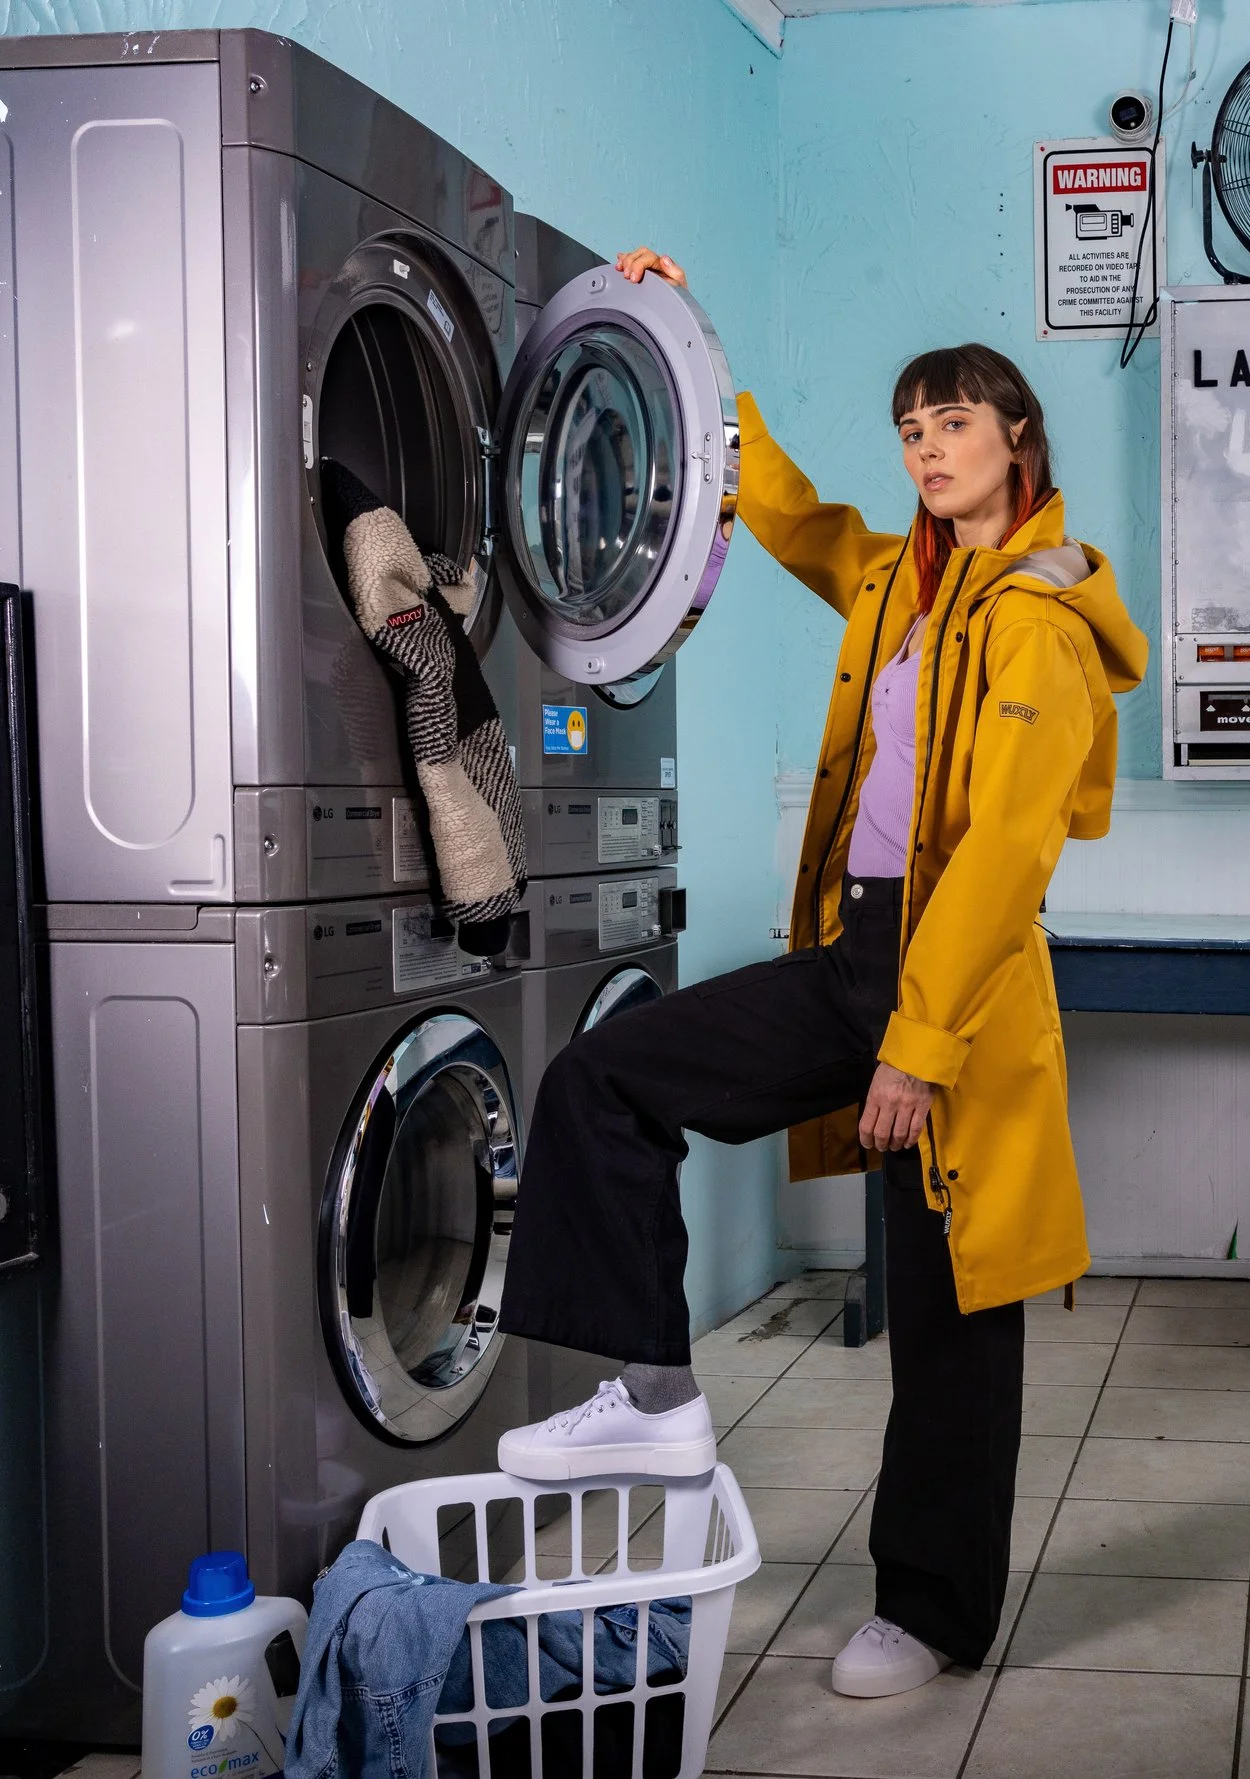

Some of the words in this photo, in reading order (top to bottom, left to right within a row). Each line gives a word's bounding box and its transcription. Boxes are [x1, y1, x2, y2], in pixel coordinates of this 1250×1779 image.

[1057, 167, 1141, 189] WARNING
[1082, 252, 1115, 260] ACTIVITIES
[1059, 264, 1093, 272] RECORDED
[1106, 262, 1124, 270] VIDEO
[1109, 274, 1122, 282] THE
[1066, 286, 1110, 294] PROSECUTION
[1058, 298, 1077, 306] CRIME
[1078, 298, 1115, 306] COMMITTED
[1116, 296, 1144, 304] AGAIST
[1095, 308, 1122, 316] FACILITY
[388, 608, 422, 626] WUXLY
[544, 708, 558, 717] Please
[1001, 704, 1036, 720] WUXLY
[544, 718, 556, 726] Wear
[544, 727, 555, 735] Face
[556, 728, 566, 736] Mask
[323, 808, 334, 819] LG
[324, 926, 334, 938] LG
[191, 1728, 209, 1741] 0%
